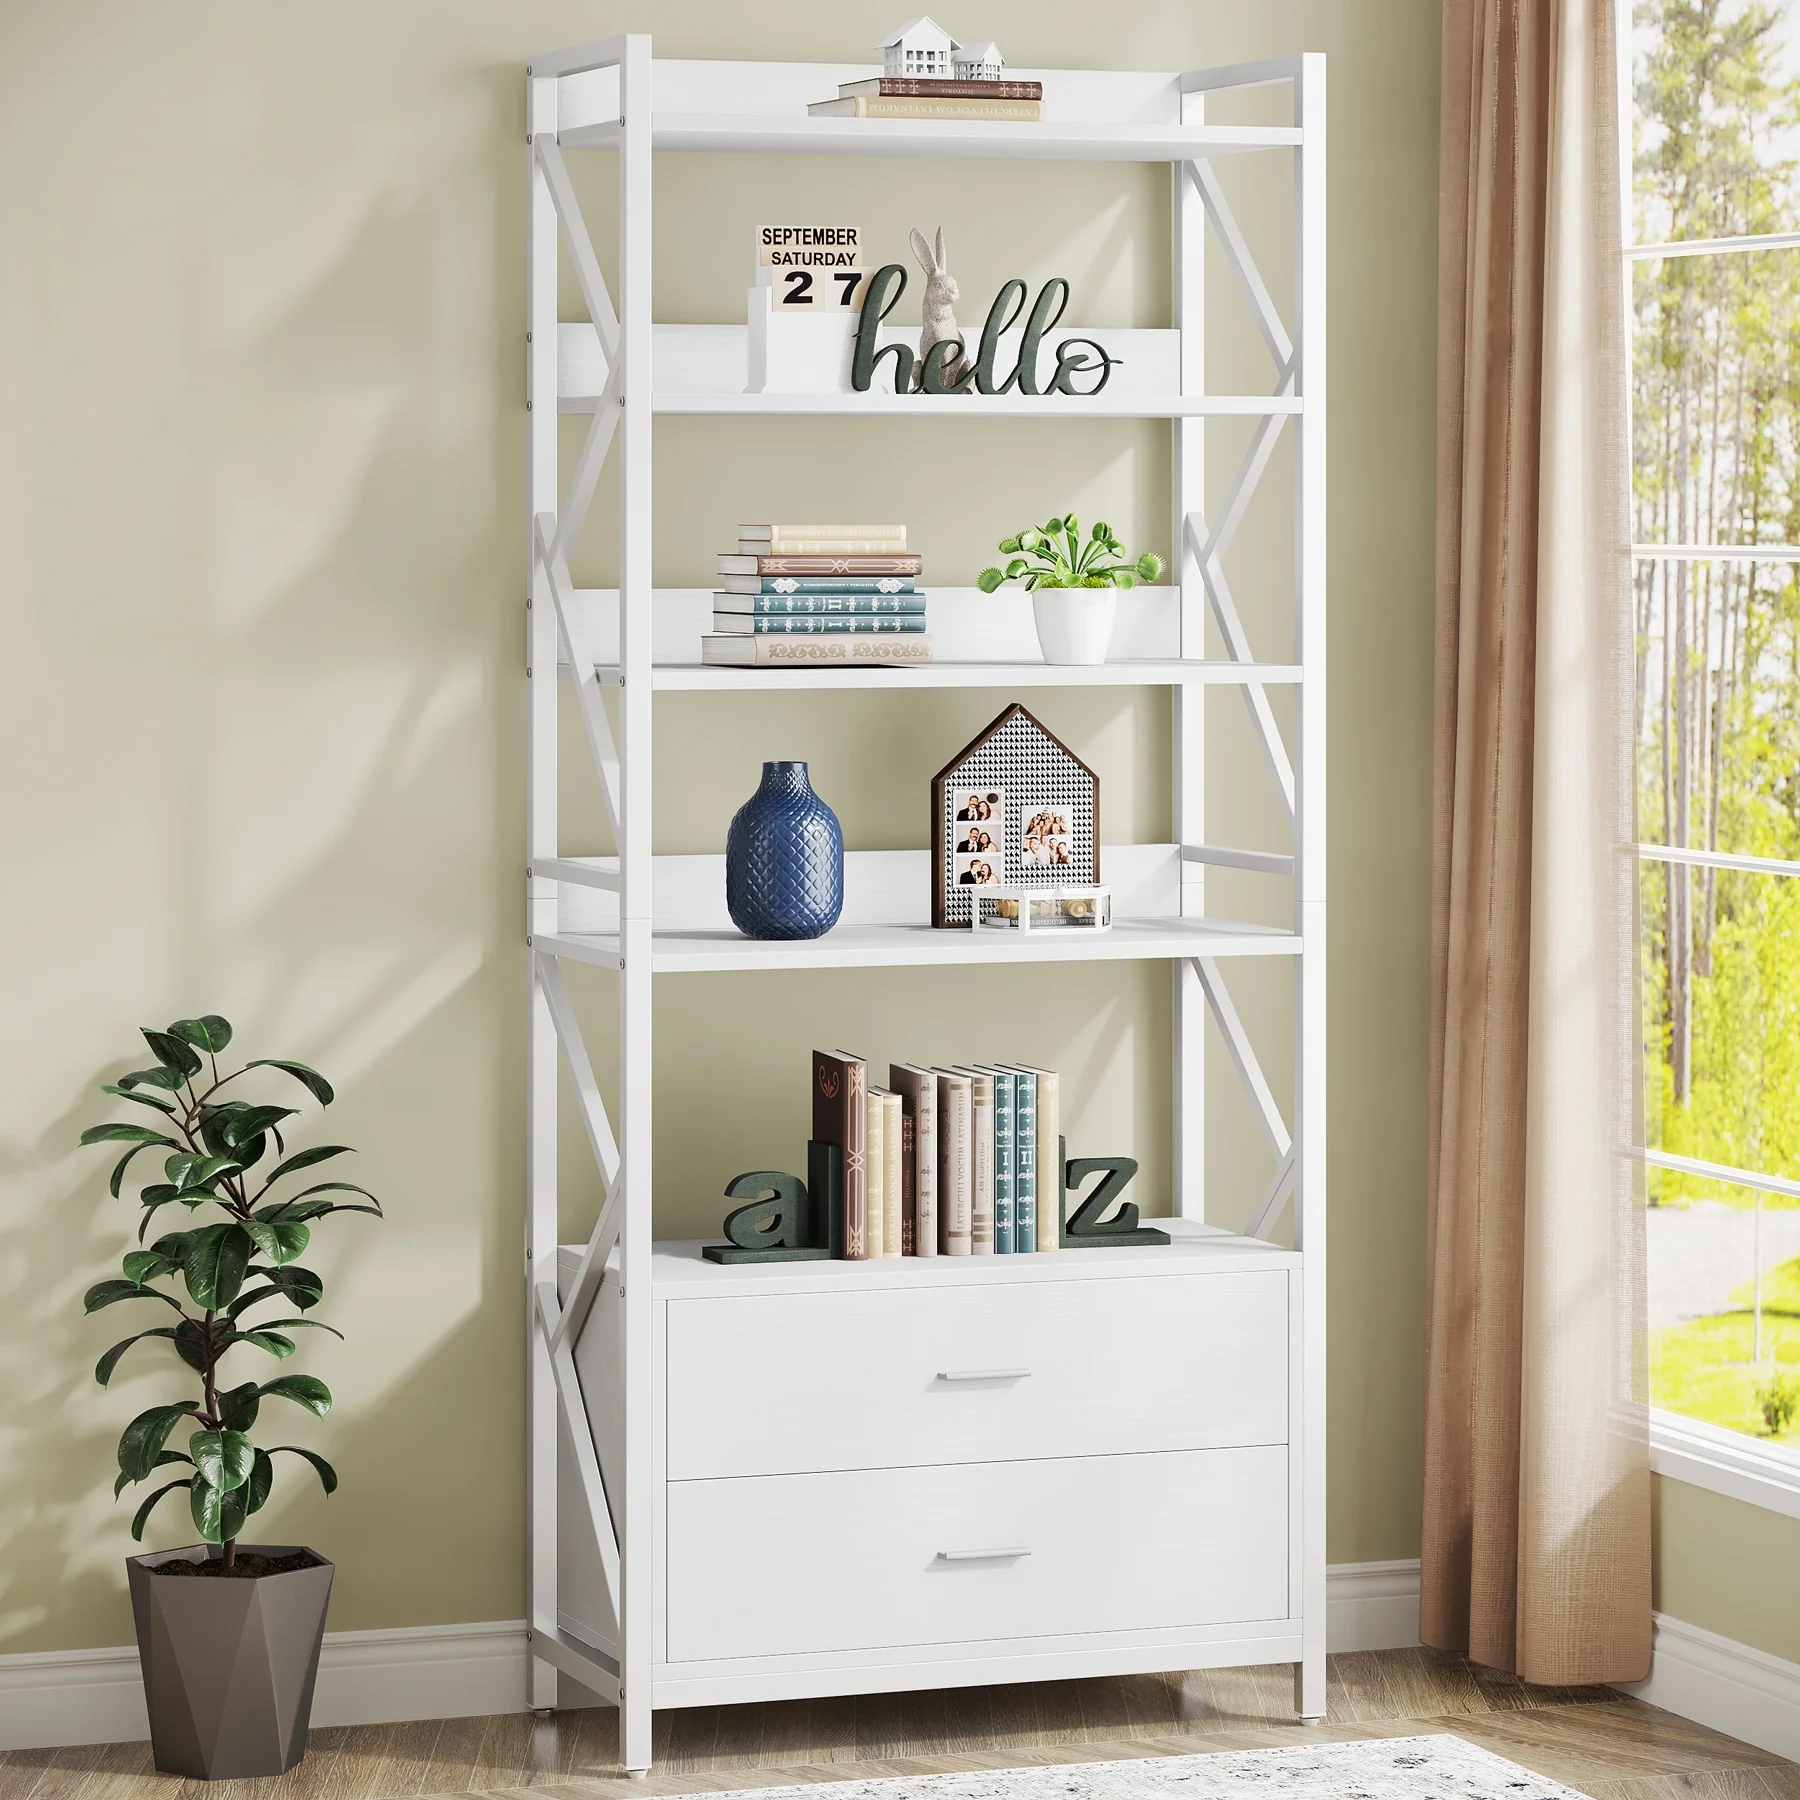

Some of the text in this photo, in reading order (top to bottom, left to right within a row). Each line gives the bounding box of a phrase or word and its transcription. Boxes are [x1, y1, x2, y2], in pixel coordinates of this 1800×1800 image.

[867, 103, 1038, 117] LATERCULI VOCUM LATINARUM
[762, 228, 857, 246] SEPTEMBER
[771, 251, 857, 266] SATURDAY
[783, 271, 862, 306] 2 7
[851, 263, 1124, 395] hello
[956, 1091, 966, 1230] LATERCULI VOCUM LATINARUM
[1020, 1151, 1032, 1165] II
[723, 1170, 809, 1250] a
[1065, 1156, 1140, 1235] z
